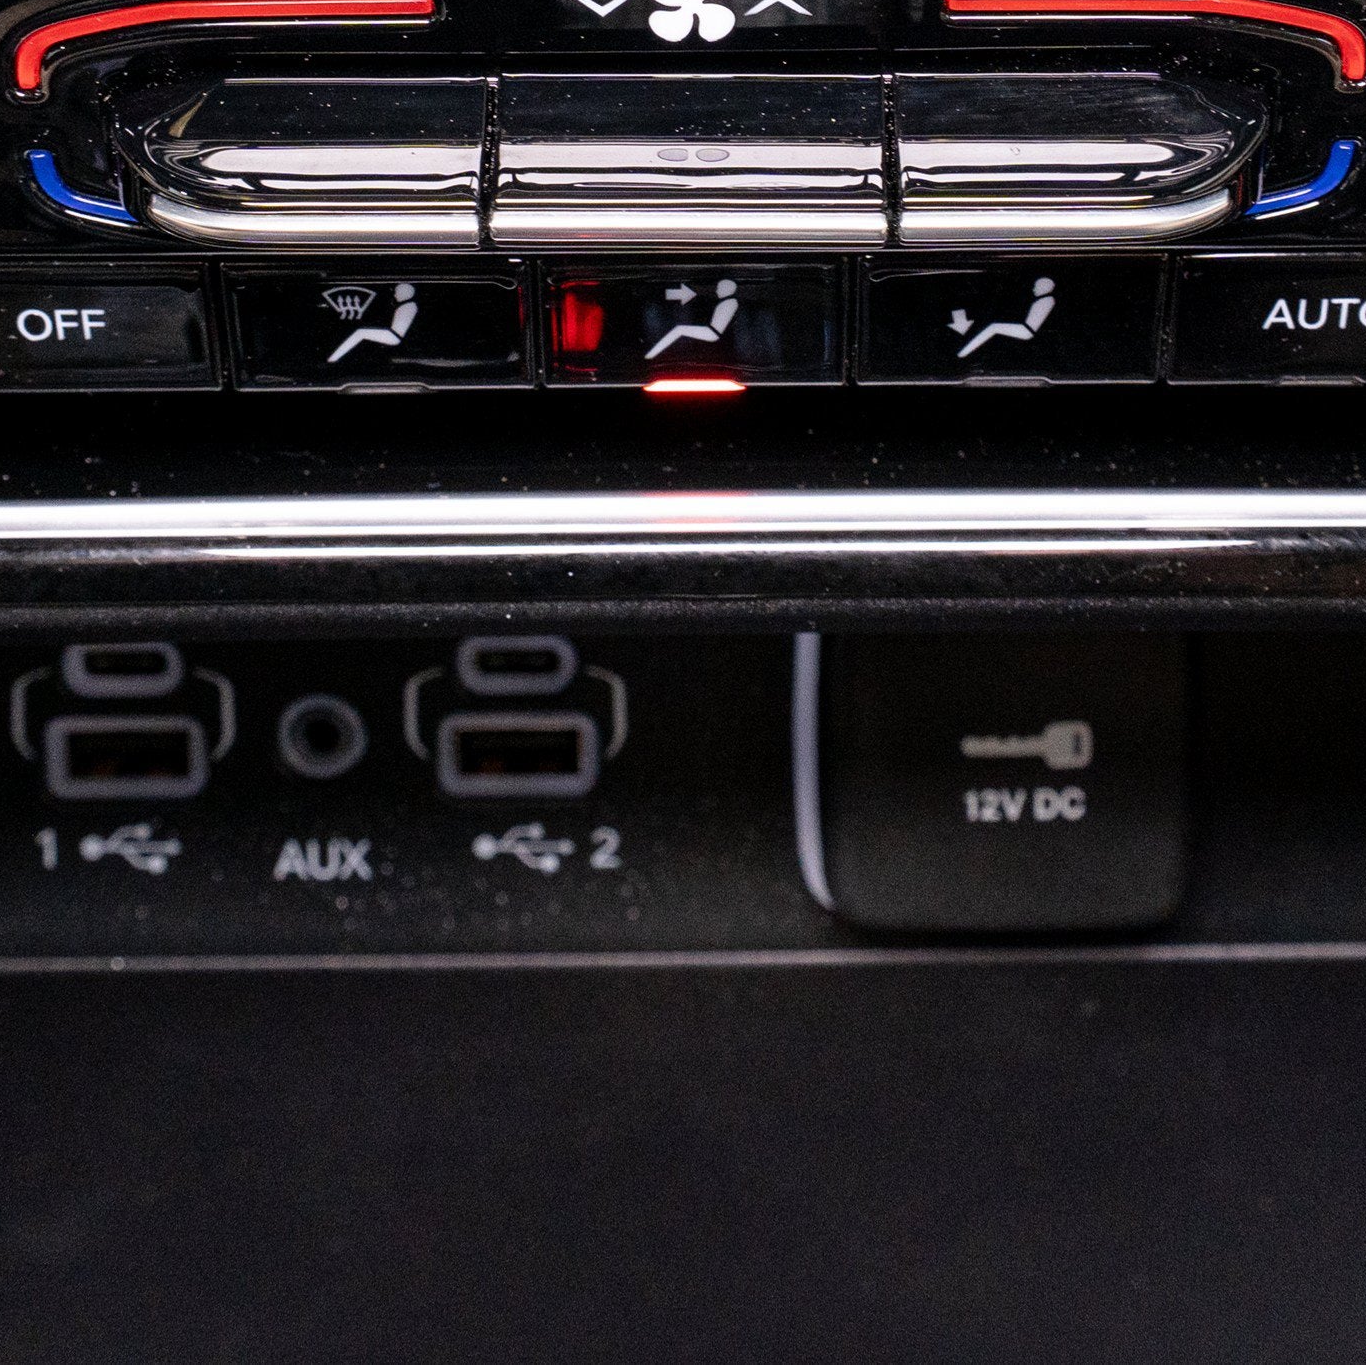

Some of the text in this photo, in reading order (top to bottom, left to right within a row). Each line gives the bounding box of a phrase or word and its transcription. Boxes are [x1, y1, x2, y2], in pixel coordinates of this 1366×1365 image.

[17, 309, 105, 341] OFF
[966, 787, 1085, 822] 12V DC
[37, 829, 57, 869] 1
[274, 839, 372, 881] AUX
[590, 827, 620, 869] 2
